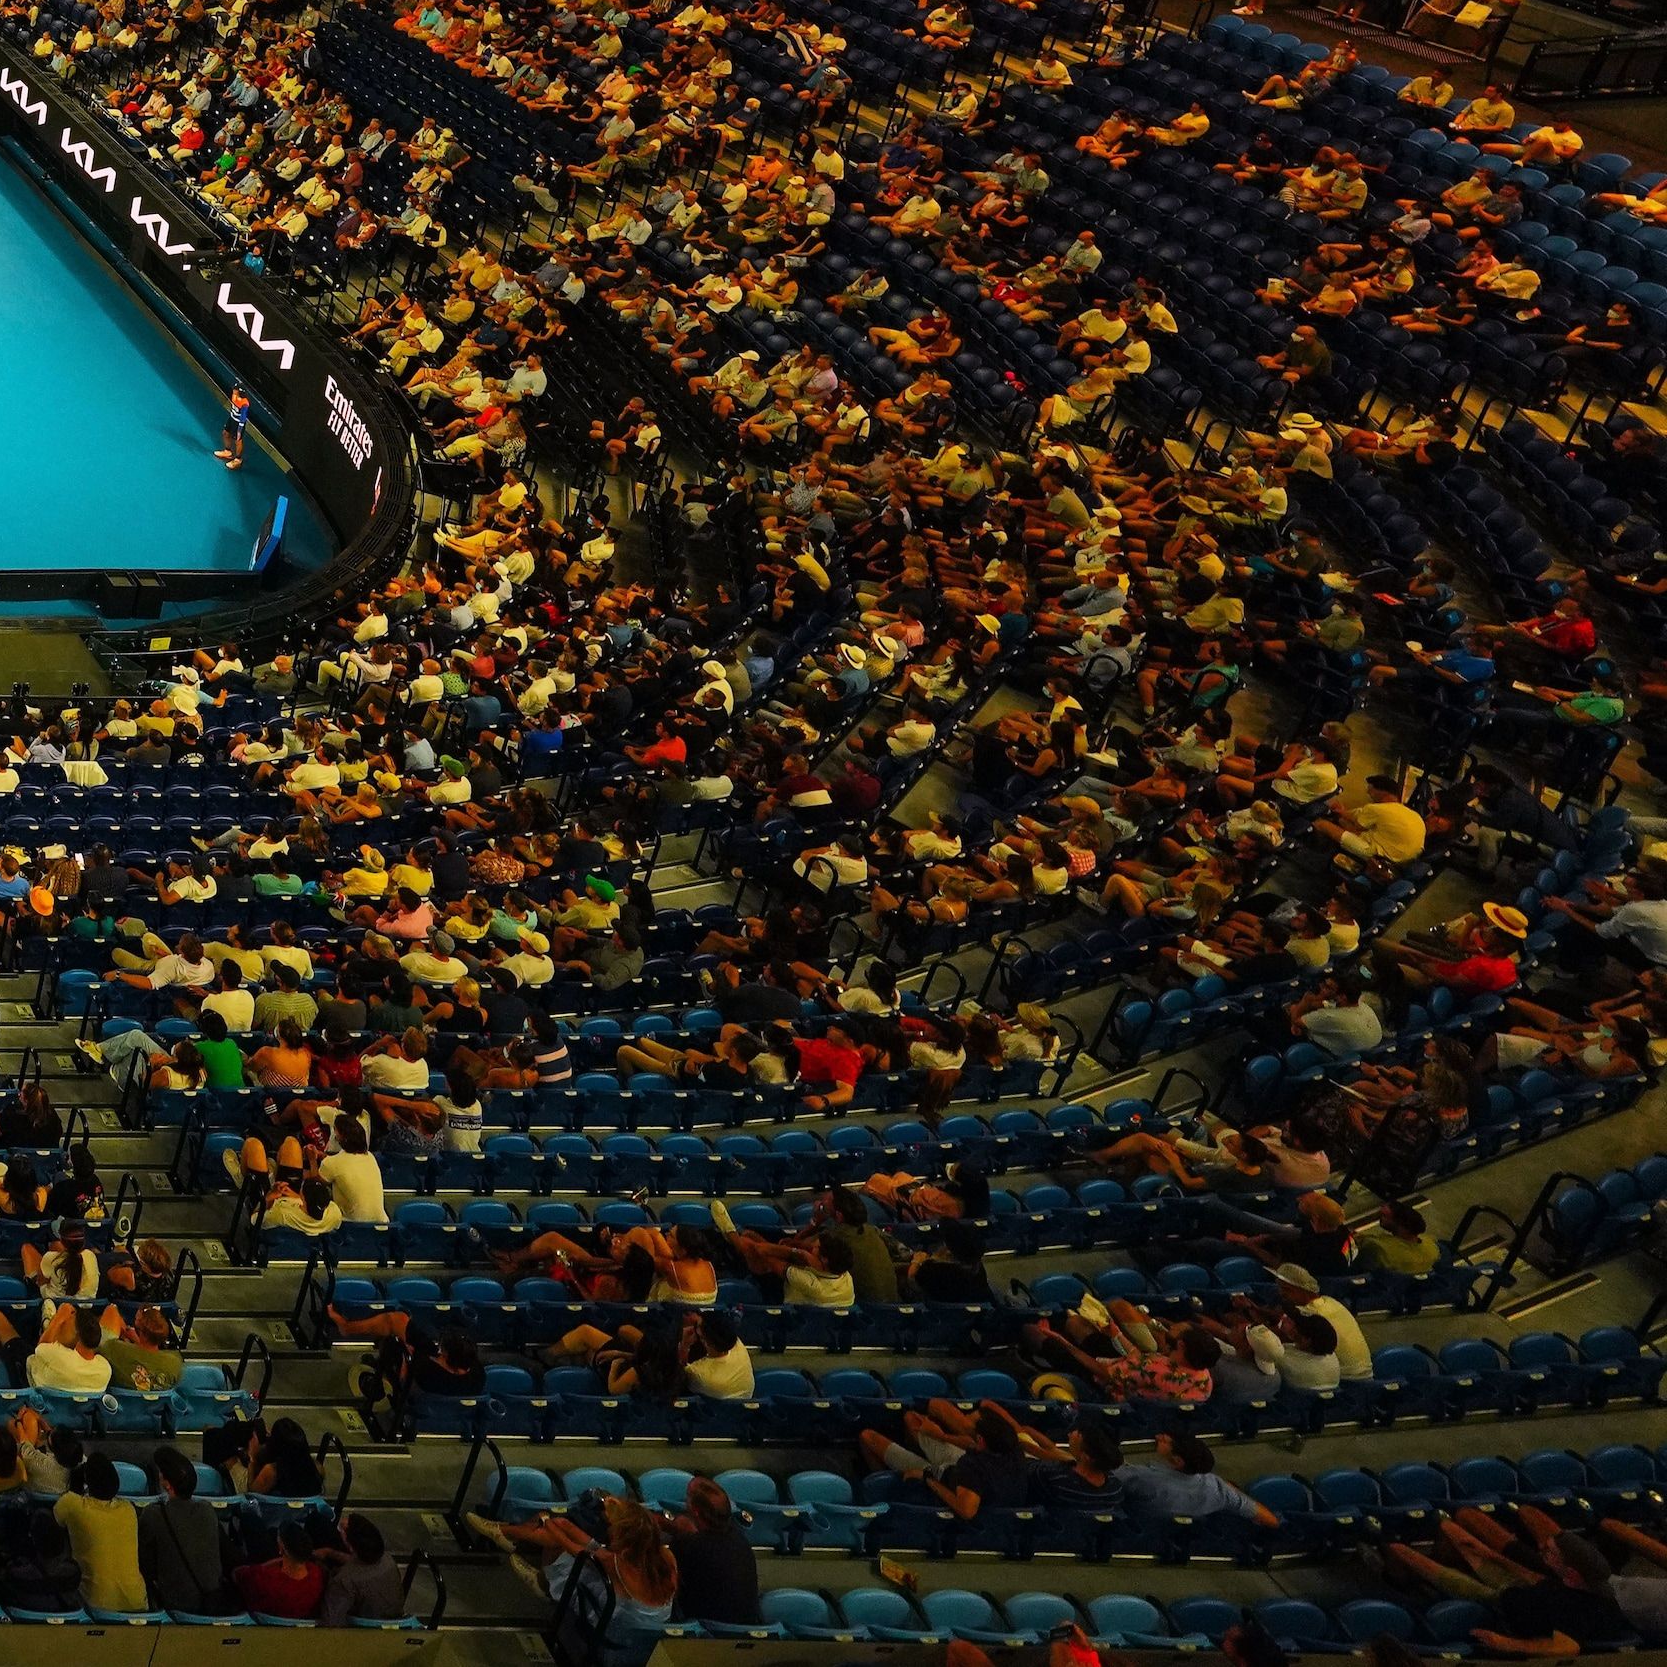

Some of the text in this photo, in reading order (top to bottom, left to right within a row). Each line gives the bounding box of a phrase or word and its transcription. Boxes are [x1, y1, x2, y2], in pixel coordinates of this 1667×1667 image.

[218, 283, 296, 369] KIA
[324, 374, 374, 458] Emirates
[327, 409, 365, 470] FLY BETTER
